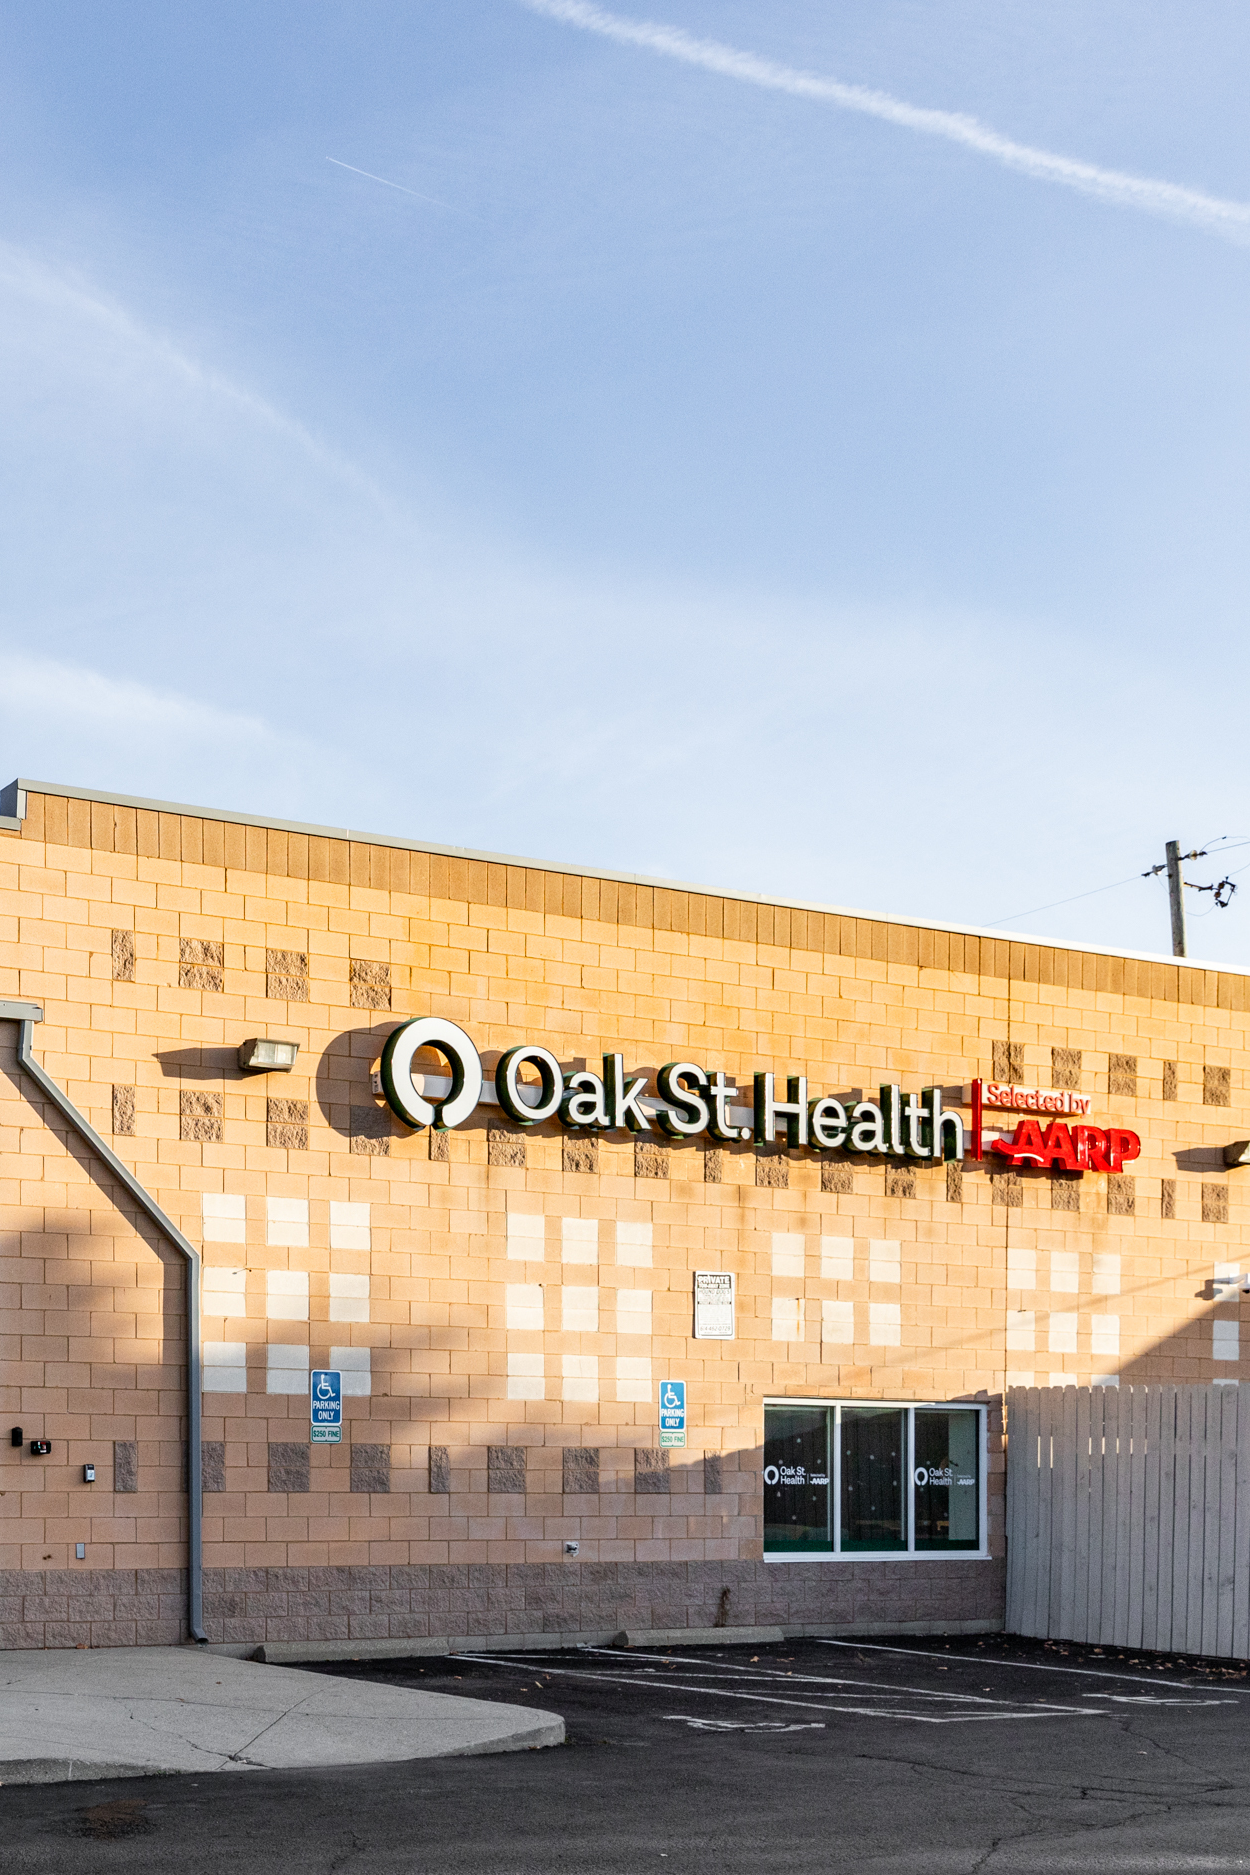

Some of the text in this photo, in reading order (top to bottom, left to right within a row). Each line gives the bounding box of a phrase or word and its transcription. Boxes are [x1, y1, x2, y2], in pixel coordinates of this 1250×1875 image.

[497, 1045, 964, 1162] Oak St. Health
[987, 1083, 1092, 1118] Selected by
[991, 1119, 1142, 1174] AARP
[698, 1276, 730, 1284] PRIVATE
[313, 1401, 340, 1410] PARKING
[318, 1411, 334, 1420] ONLY
[661, 1408, 684, 1417] PARKING
[665, 1418, 680, 1427] ONLY
[313, 1429, 326, 1437] $250
[661, 1435, 673, 1443] $250
[780, 1466, 795, 1476] Oak
[928, 1467, 943, 1477] Oak
[780, 1475, 805, 1485] Health
[929, 1477, 953, 1486] Health
